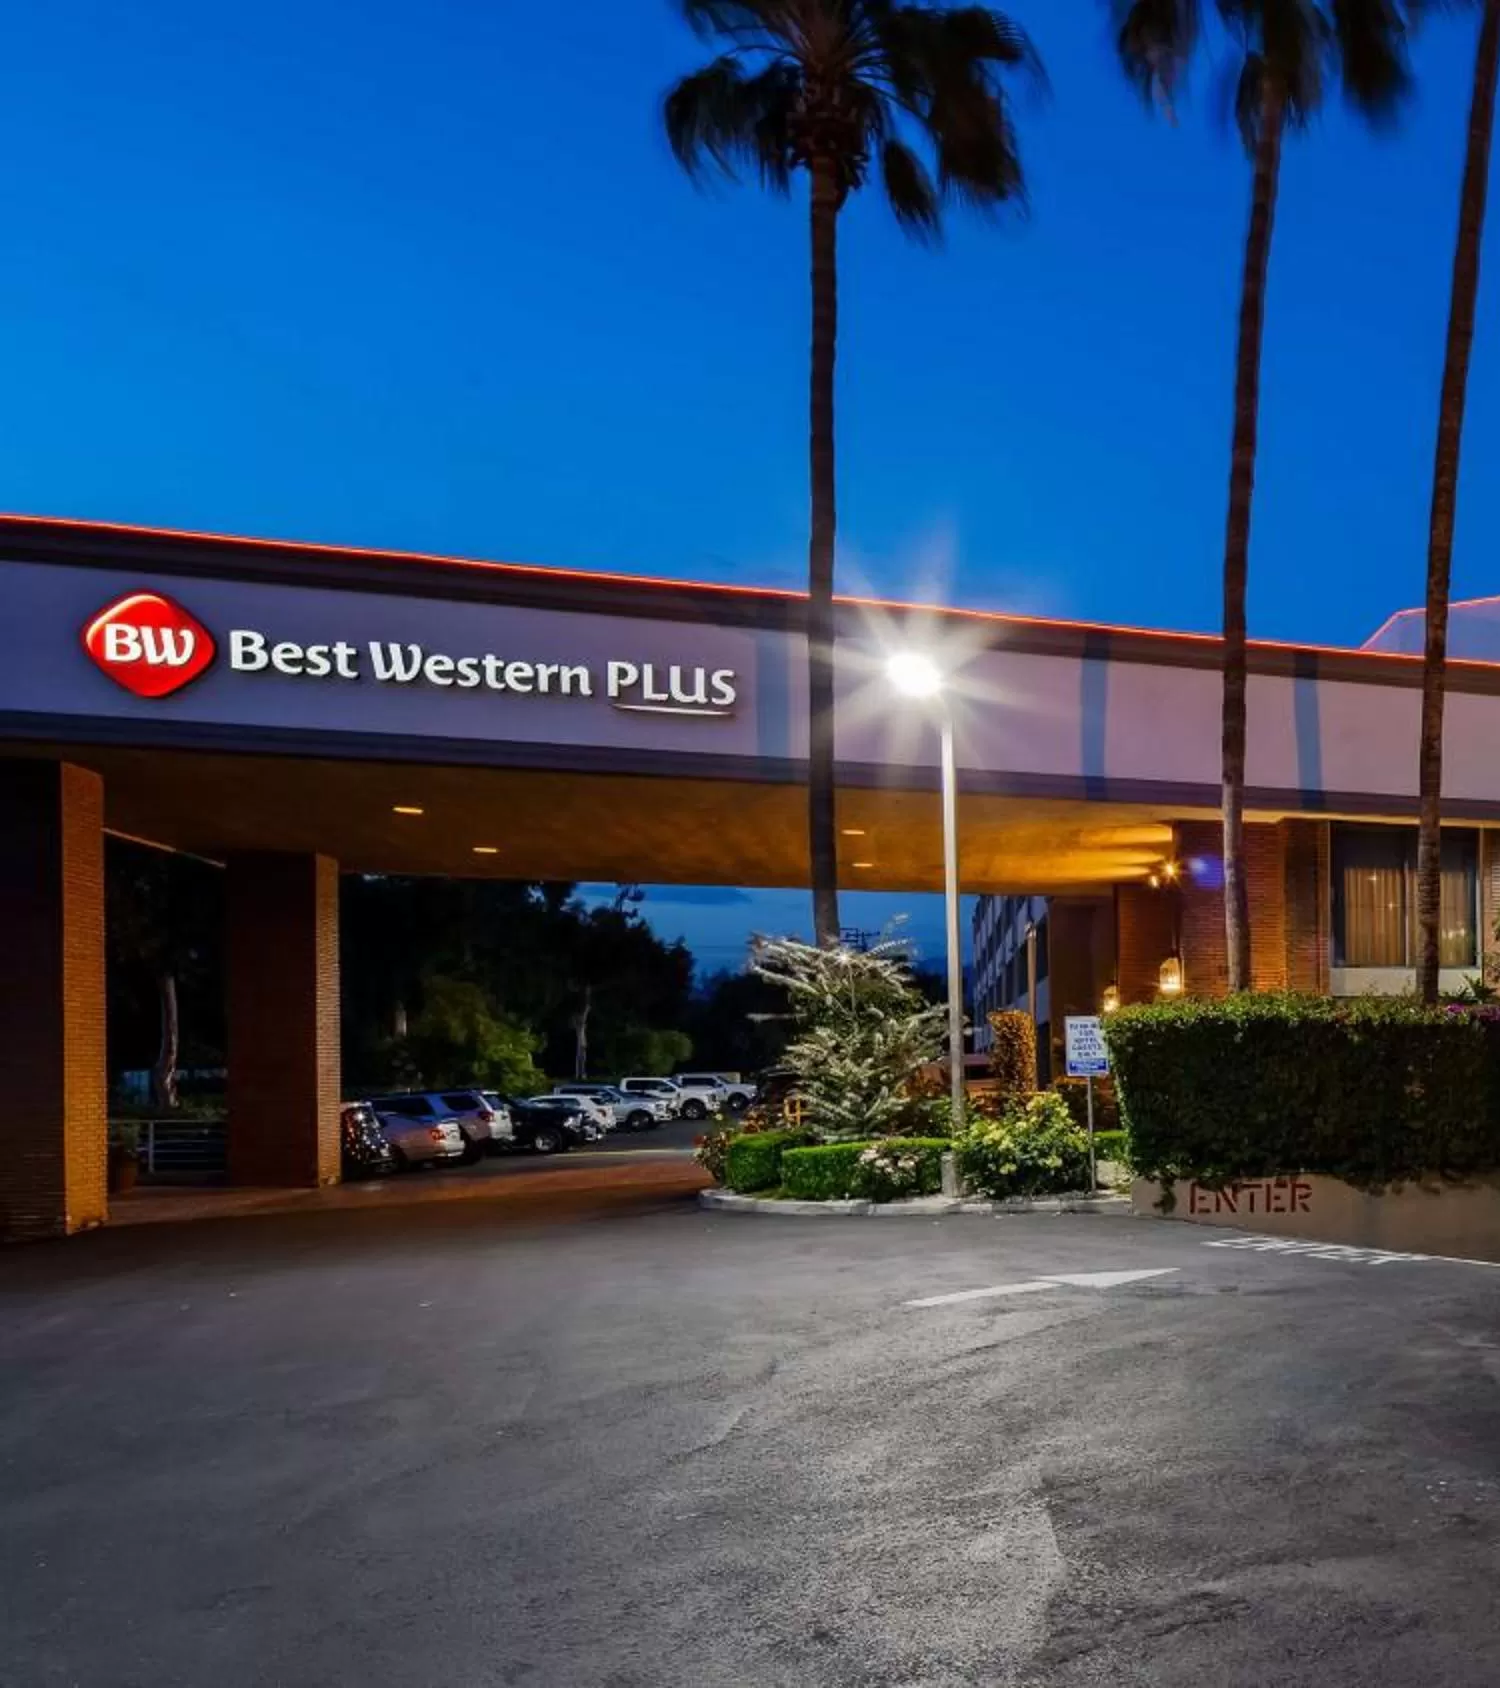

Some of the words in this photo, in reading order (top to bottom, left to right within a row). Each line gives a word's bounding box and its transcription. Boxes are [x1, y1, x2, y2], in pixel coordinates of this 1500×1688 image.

[104, 622, 195, 666] BW
[229, 630, 358, 678] Best
[368, 641, 592, 696] Western
[607, 661, 736, 705] PLUS
[1189, 1182, 1313, 1214] ENTER
